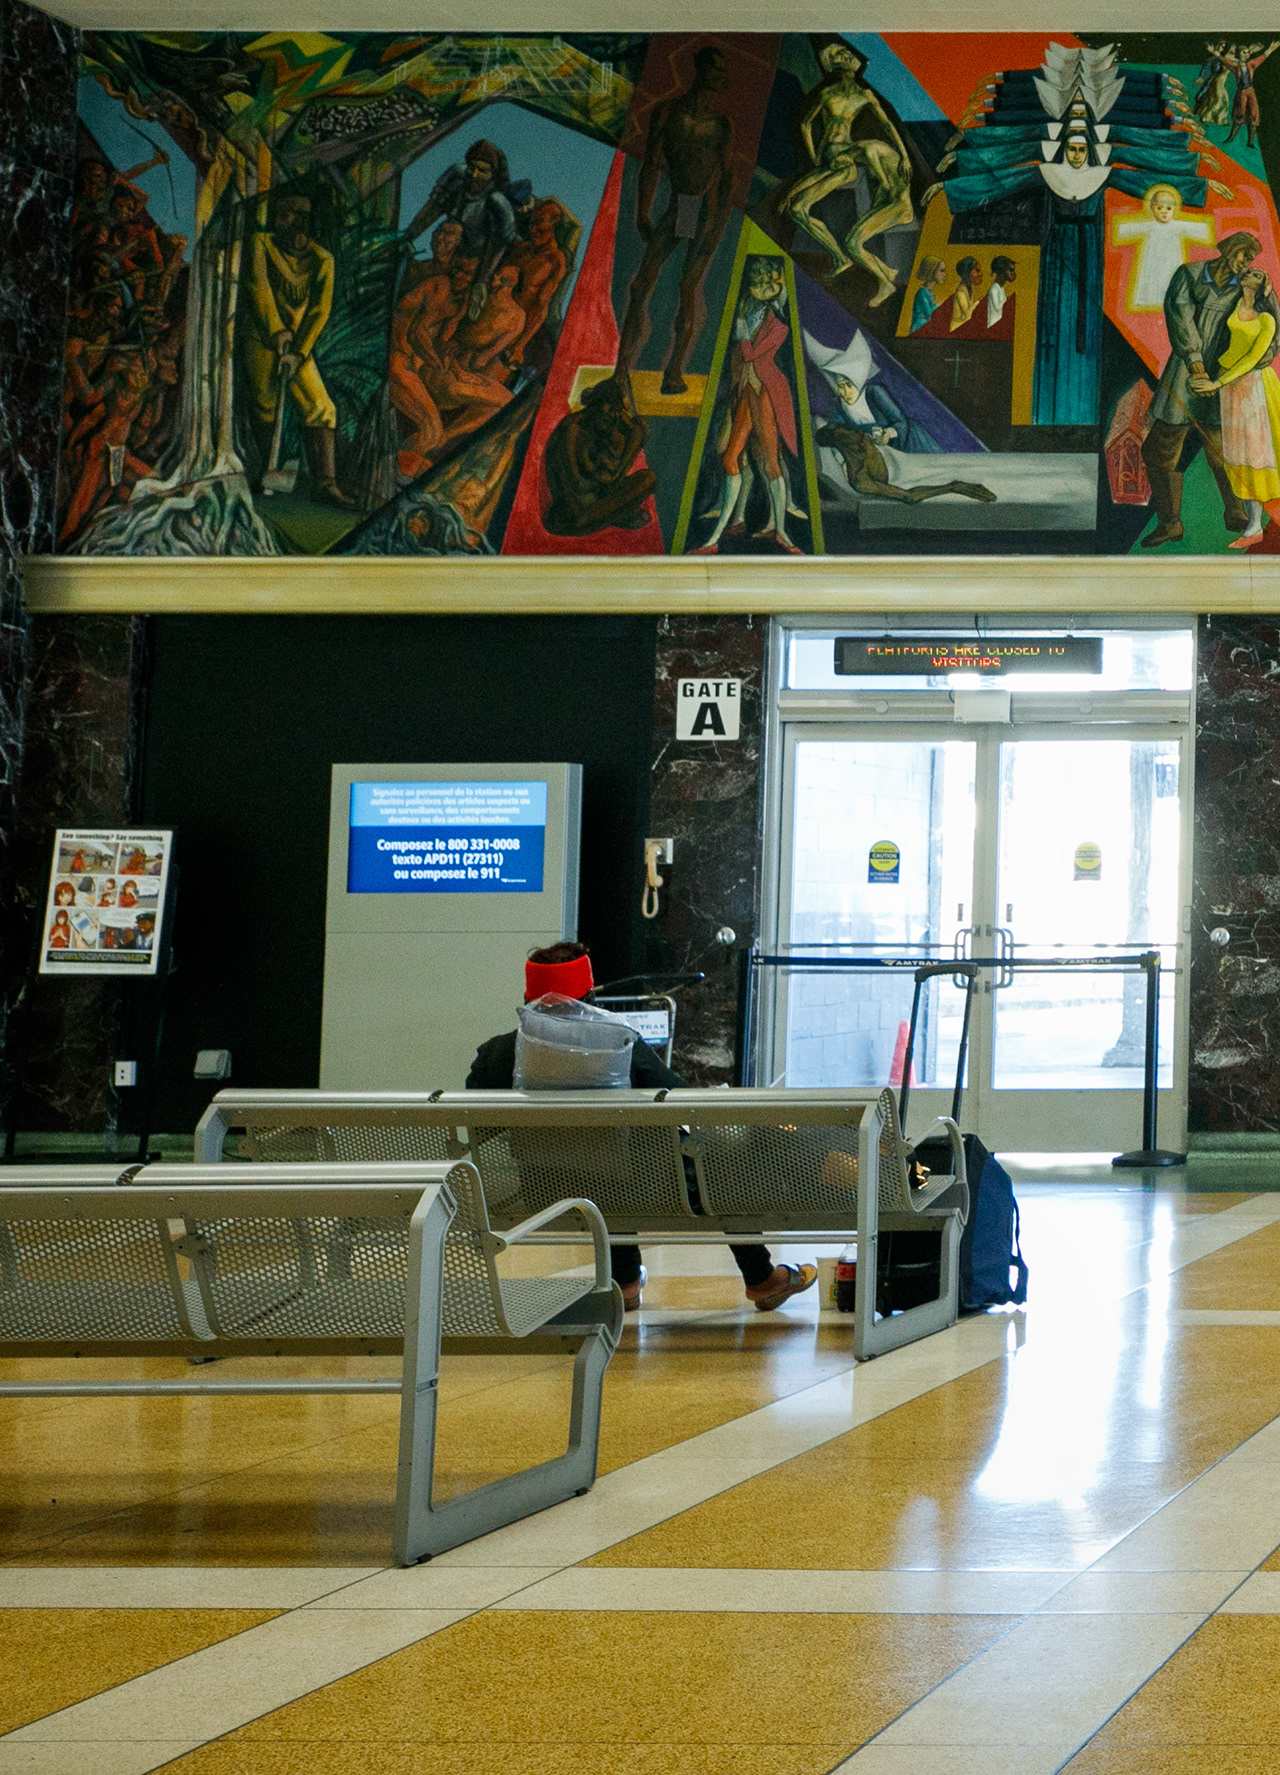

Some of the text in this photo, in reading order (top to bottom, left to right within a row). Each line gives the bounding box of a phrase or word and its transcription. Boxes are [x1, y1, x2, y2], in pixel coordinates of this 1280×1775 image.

[682, 682, 737, 698] GATE
[690, 702, 726, 736] A
[376, 838, 521, 853] Composez le 800 331-0008
[392, 852, 504, 867] texto APD11 (27311)
[393, 867, 500, 882] ou composez le 911
